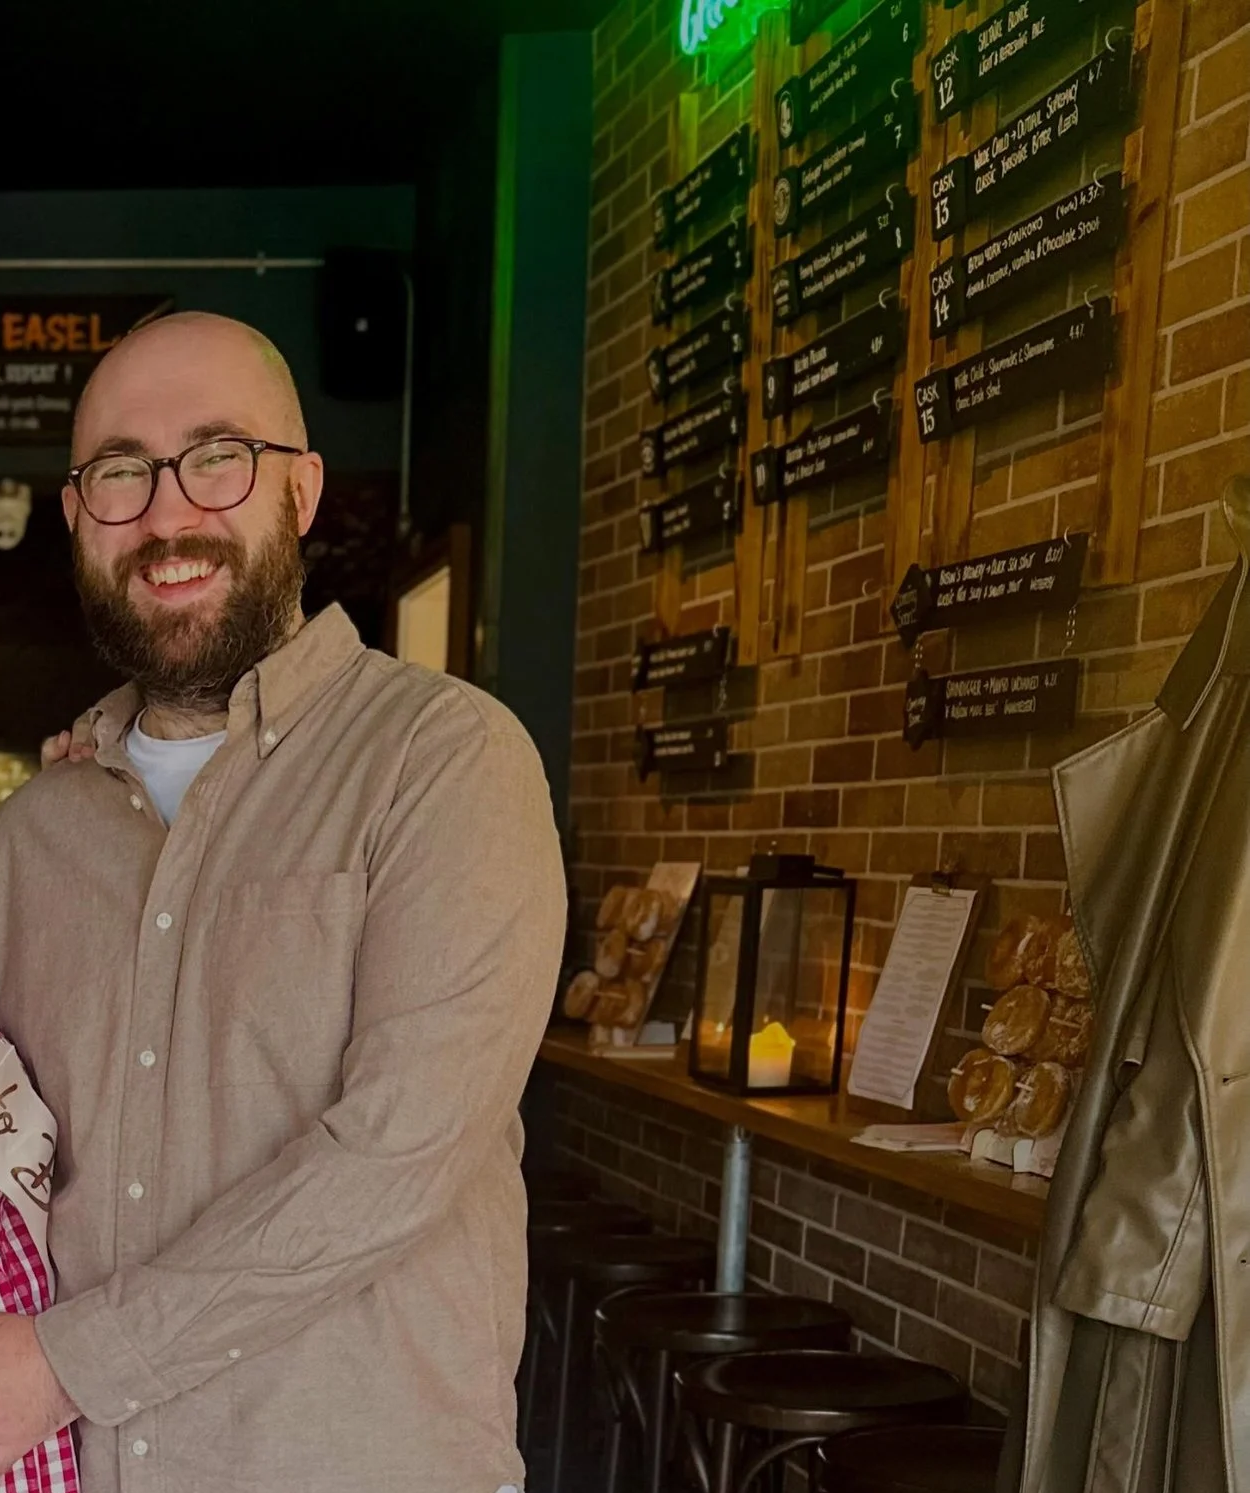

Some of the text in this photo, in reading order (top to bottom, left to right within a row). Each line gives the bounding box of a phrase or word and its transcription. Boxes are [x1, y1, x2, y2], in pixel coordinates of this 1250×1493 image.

[934, 45, 959, 81] CASK
[937, 76, 955, 111] 12
[932, 170, 956, 200] CASK
[934, 196, 950, 230] 13
[931, 266, 955, 296] CASK
[934, 294, 950, 328] 14
[1, 311, 111, 352] EASEL
[767, 375, 775, 400] 9
[916, 381, 940, 407] CASK
[920, 406, 936, 435] 15
